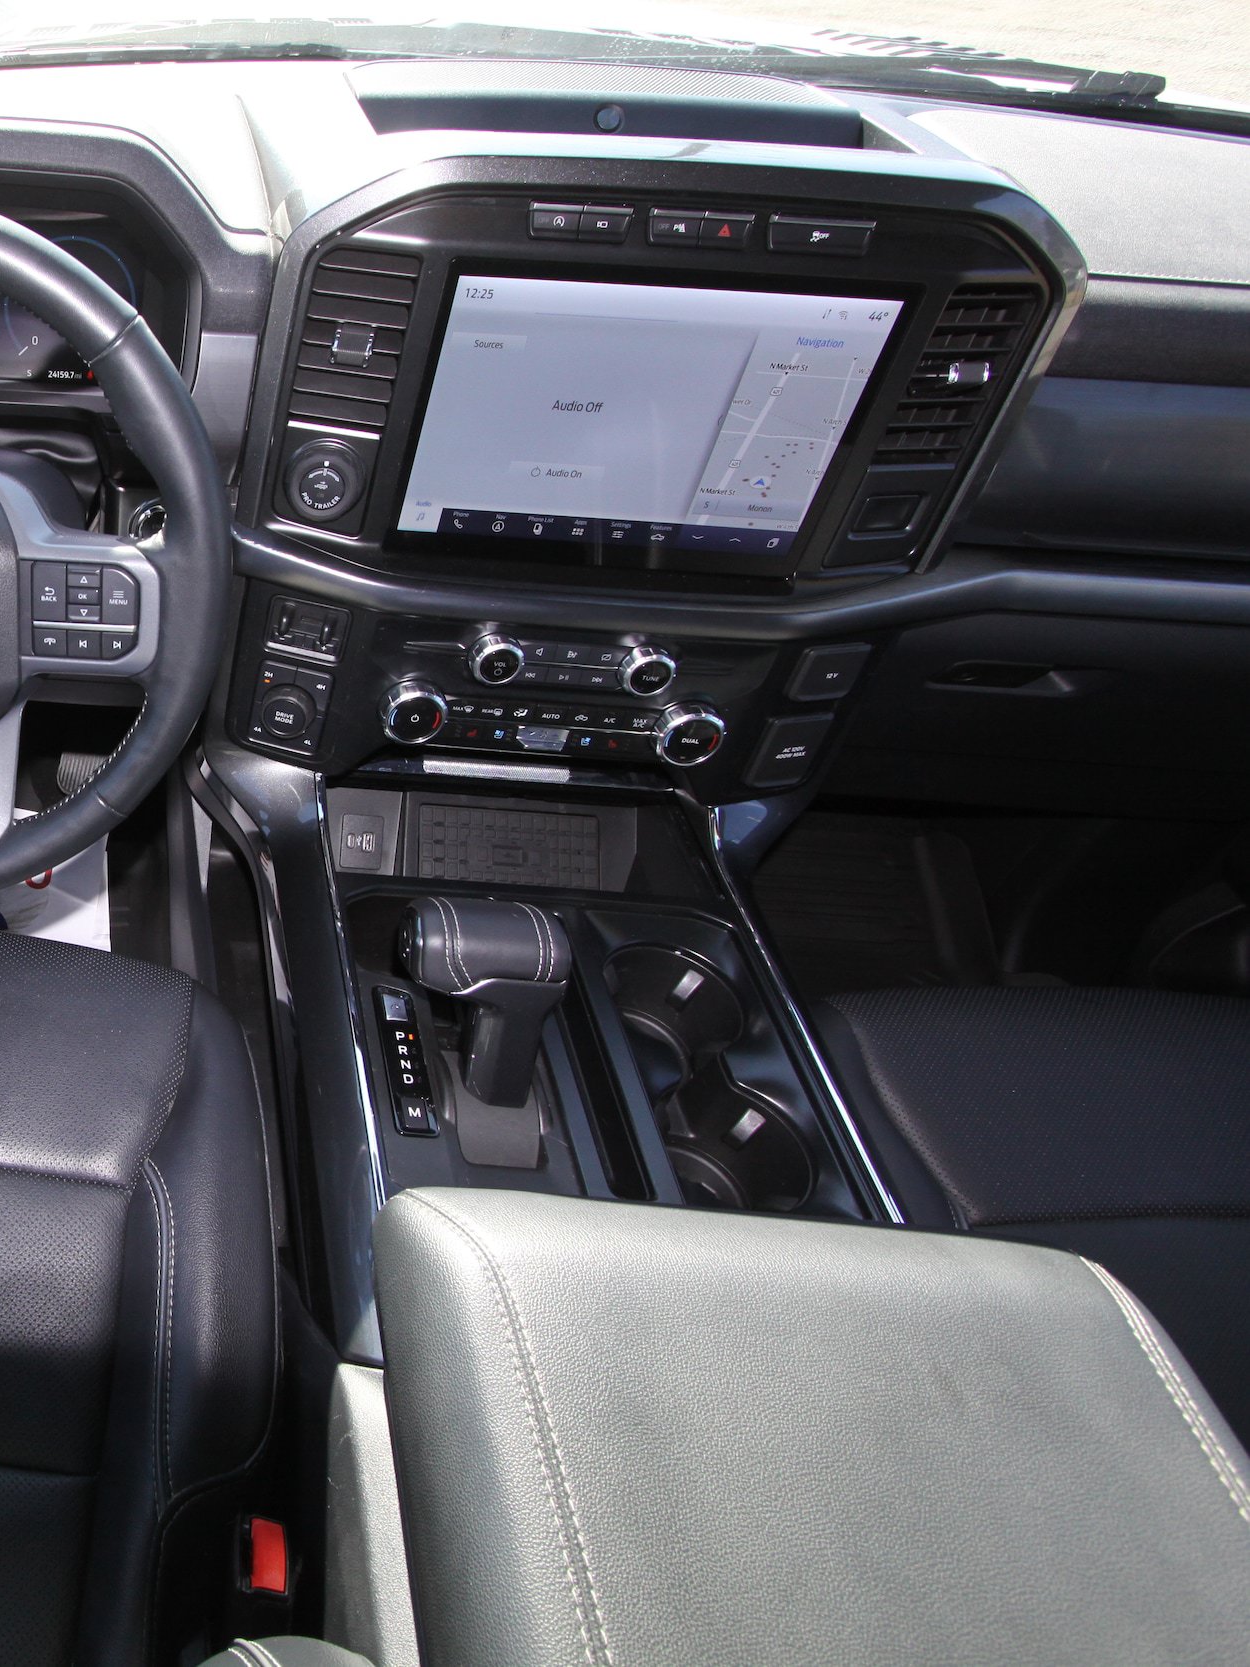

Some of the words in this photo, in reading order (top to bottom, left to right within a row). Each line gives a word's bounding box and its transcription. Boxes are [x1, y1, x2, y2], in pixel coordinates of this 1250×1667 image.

[464, 288, 494, 300] 12:25
[868, 311, 889, 322] 44°
[32, 336, 39, 346] 0
[474, 339, 504, 350] Sources
[796, 336, 844, 349] Navigation
[770, 362, 776, 370] N
[776, 363, 800, 371] Market
[800, 364, 809, 372] St
[552, 400, 584, 413] Audio
[585, 401, 604, 413] Off
[545, 468, 569, 478] Audio
[570, 470, 582, 479] On
[301, 492, 313, 505] PRO
[314, 495, 341, 509] TRAILER
[704, 501, 710, 509] S
[748, 504, 773, 513] Monon
[574, 519, 587, 527] Apps
[611, 521, 632, 529] Settings
[641, 674, 660, 682] TUNE
[316, 683, 326, 691] 4H
[274, 716, 294, 725] MODE
[275, 711, 295, 720] DRIVE
[395, 1031, 405, 1041] P
[398, 1045, 408, 1055] R
[400, 1059, 411, 1070] N
[403, 1074, 414, 1084] D
[408, 1106, 422, 1118] M
